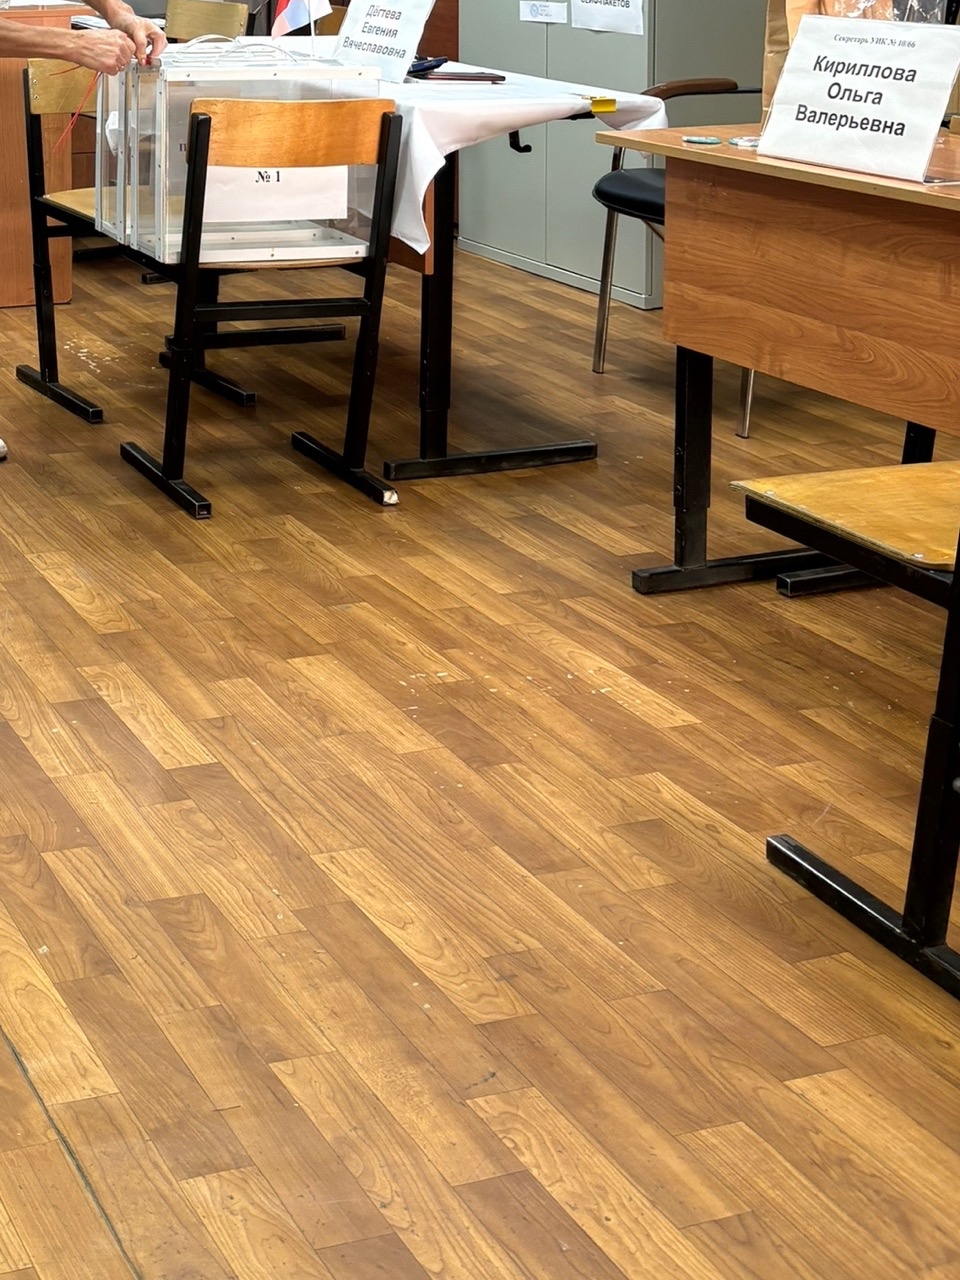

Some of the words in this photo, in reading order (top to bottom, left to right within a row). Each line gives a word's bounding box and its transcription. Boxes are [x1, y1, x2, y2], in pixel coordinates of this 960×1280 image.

[361, 21, 399, 39] Евгения
[833, 33, 869, 45] Секретарь
[342, 36, 407, 59] Вячеславовна
[812, 55, 918, 83] Кириллова
[827, 82, 884, 106] Ольга
[795, 104, 906, 137] Валерьевна
[275, 171, 281, 182] 1
